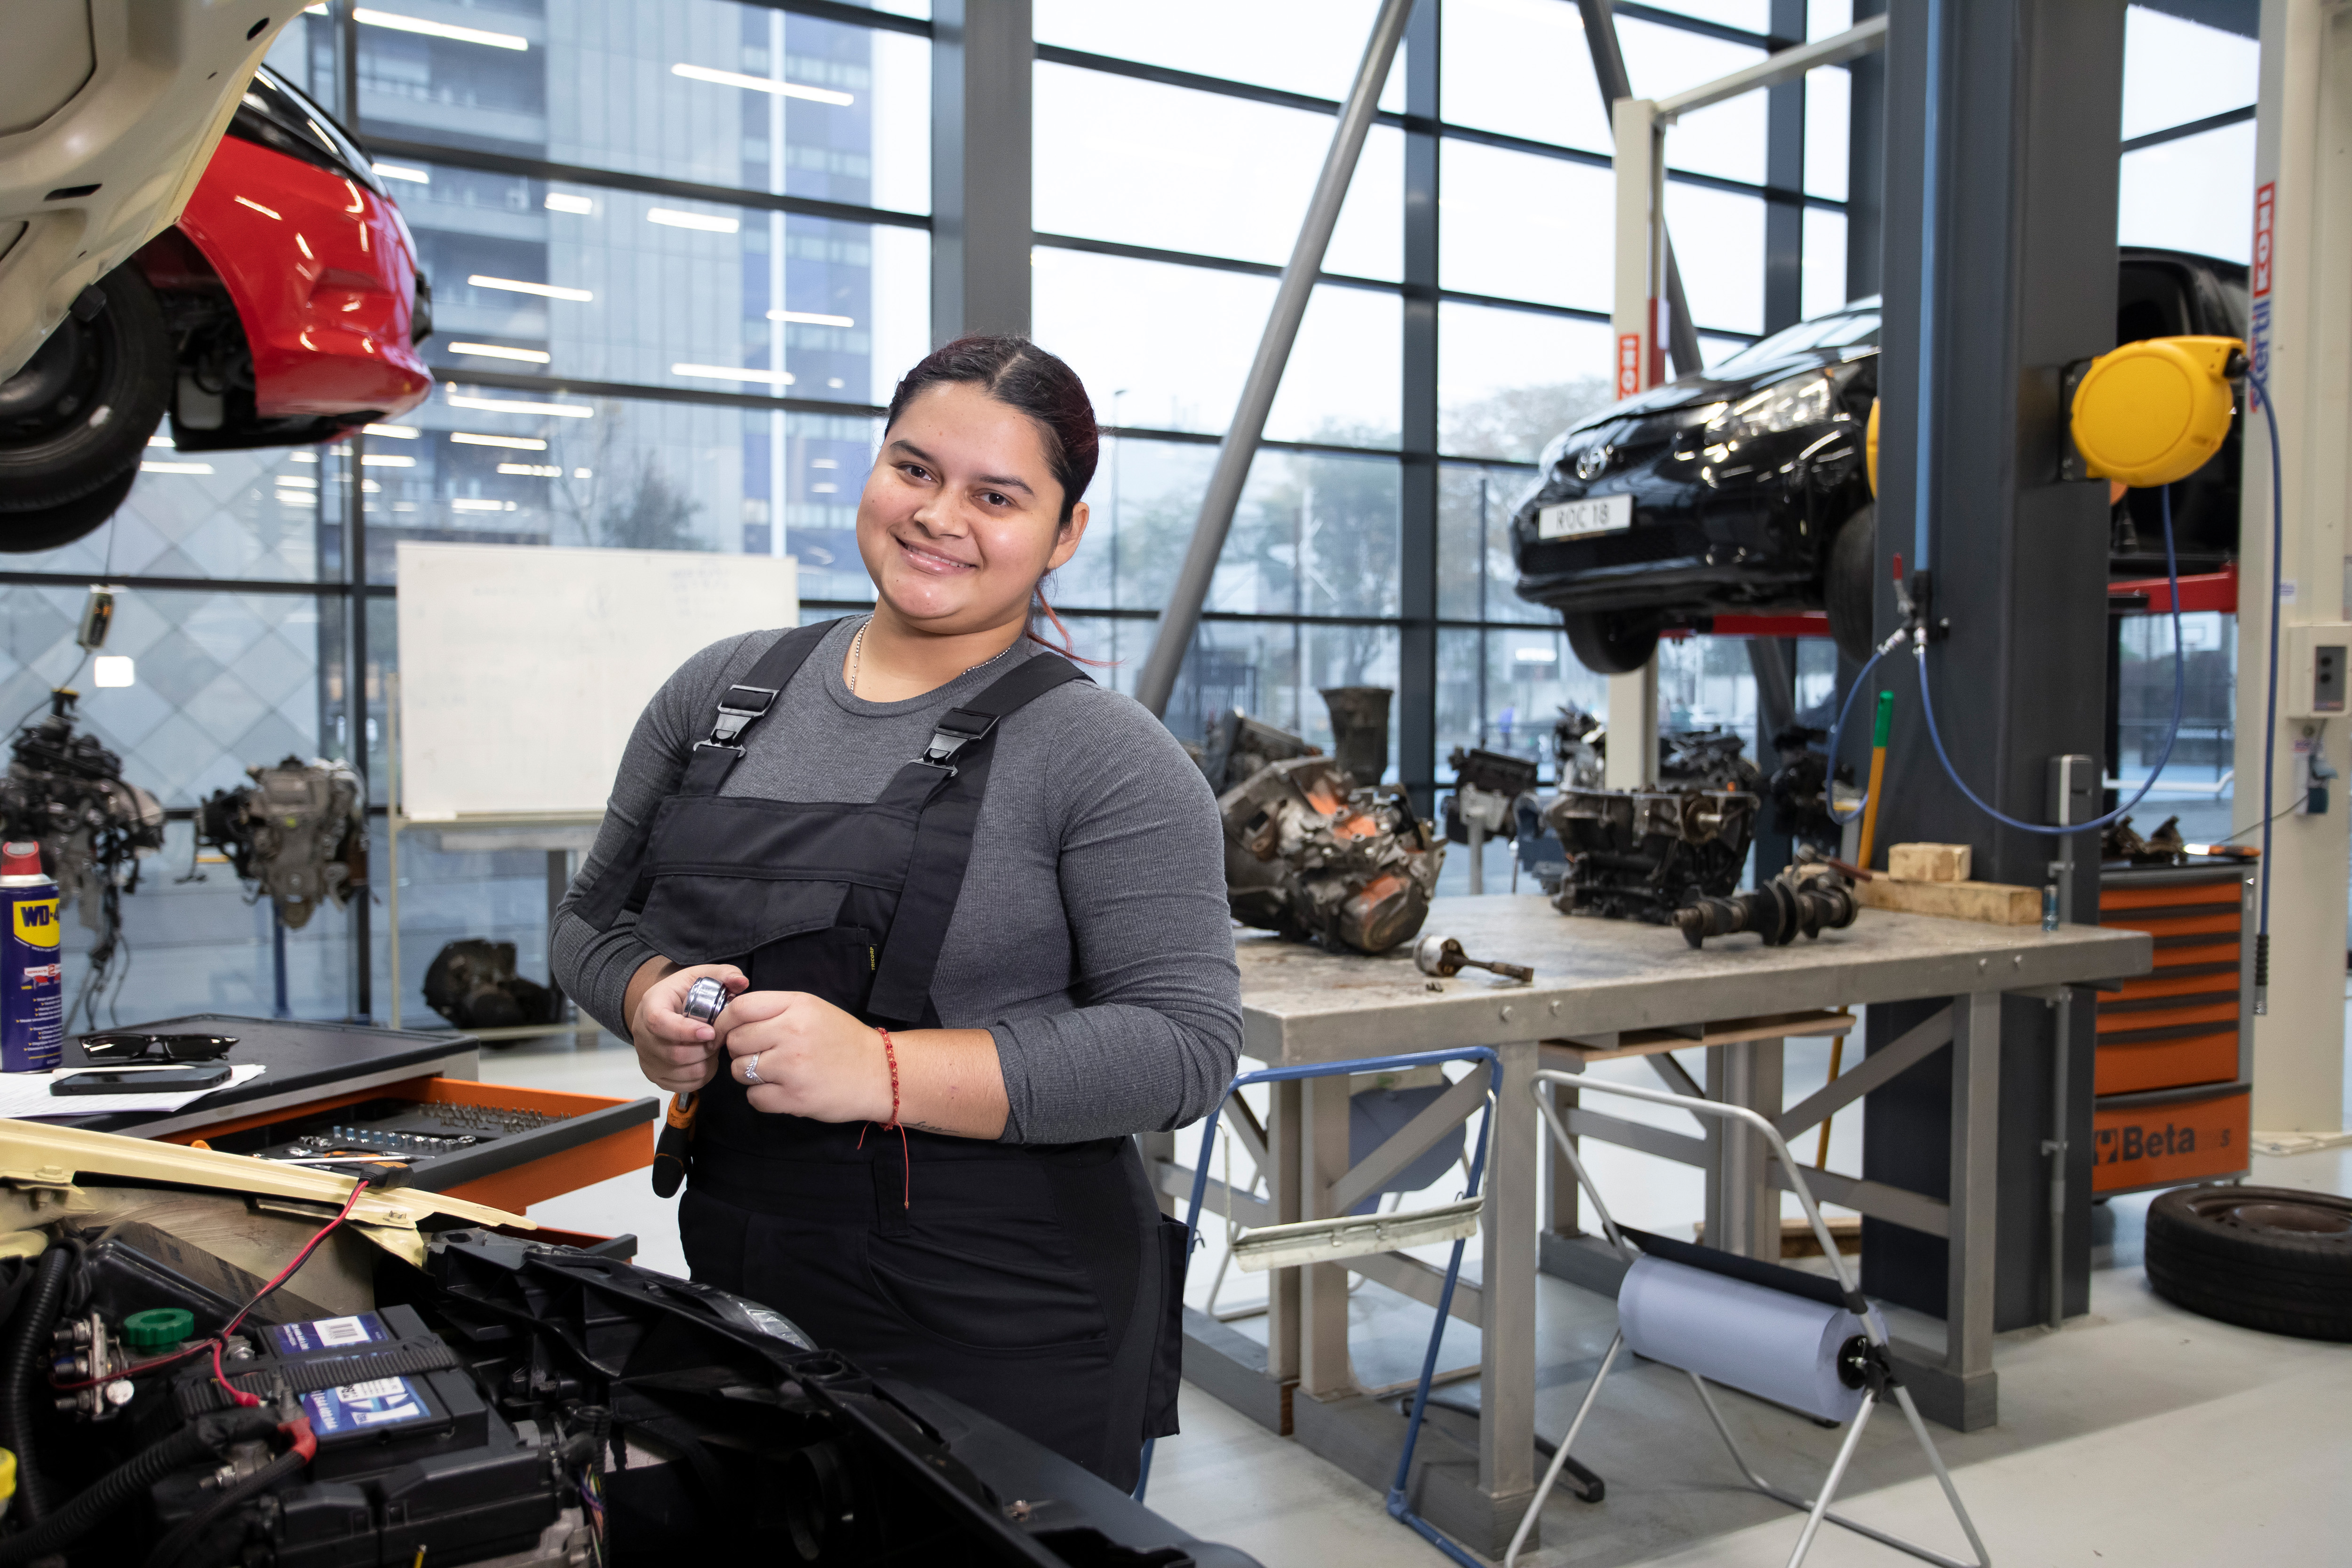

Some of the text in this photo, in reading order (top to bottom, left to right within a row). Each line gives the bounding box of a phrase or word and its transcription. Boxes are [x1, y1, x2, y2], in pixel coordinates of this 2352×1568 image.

[2256, 188, 2273, 292] KONI
[1620, 337, 1637, 398] ONI
[2122, 1123, 2195, 1161] Beta
